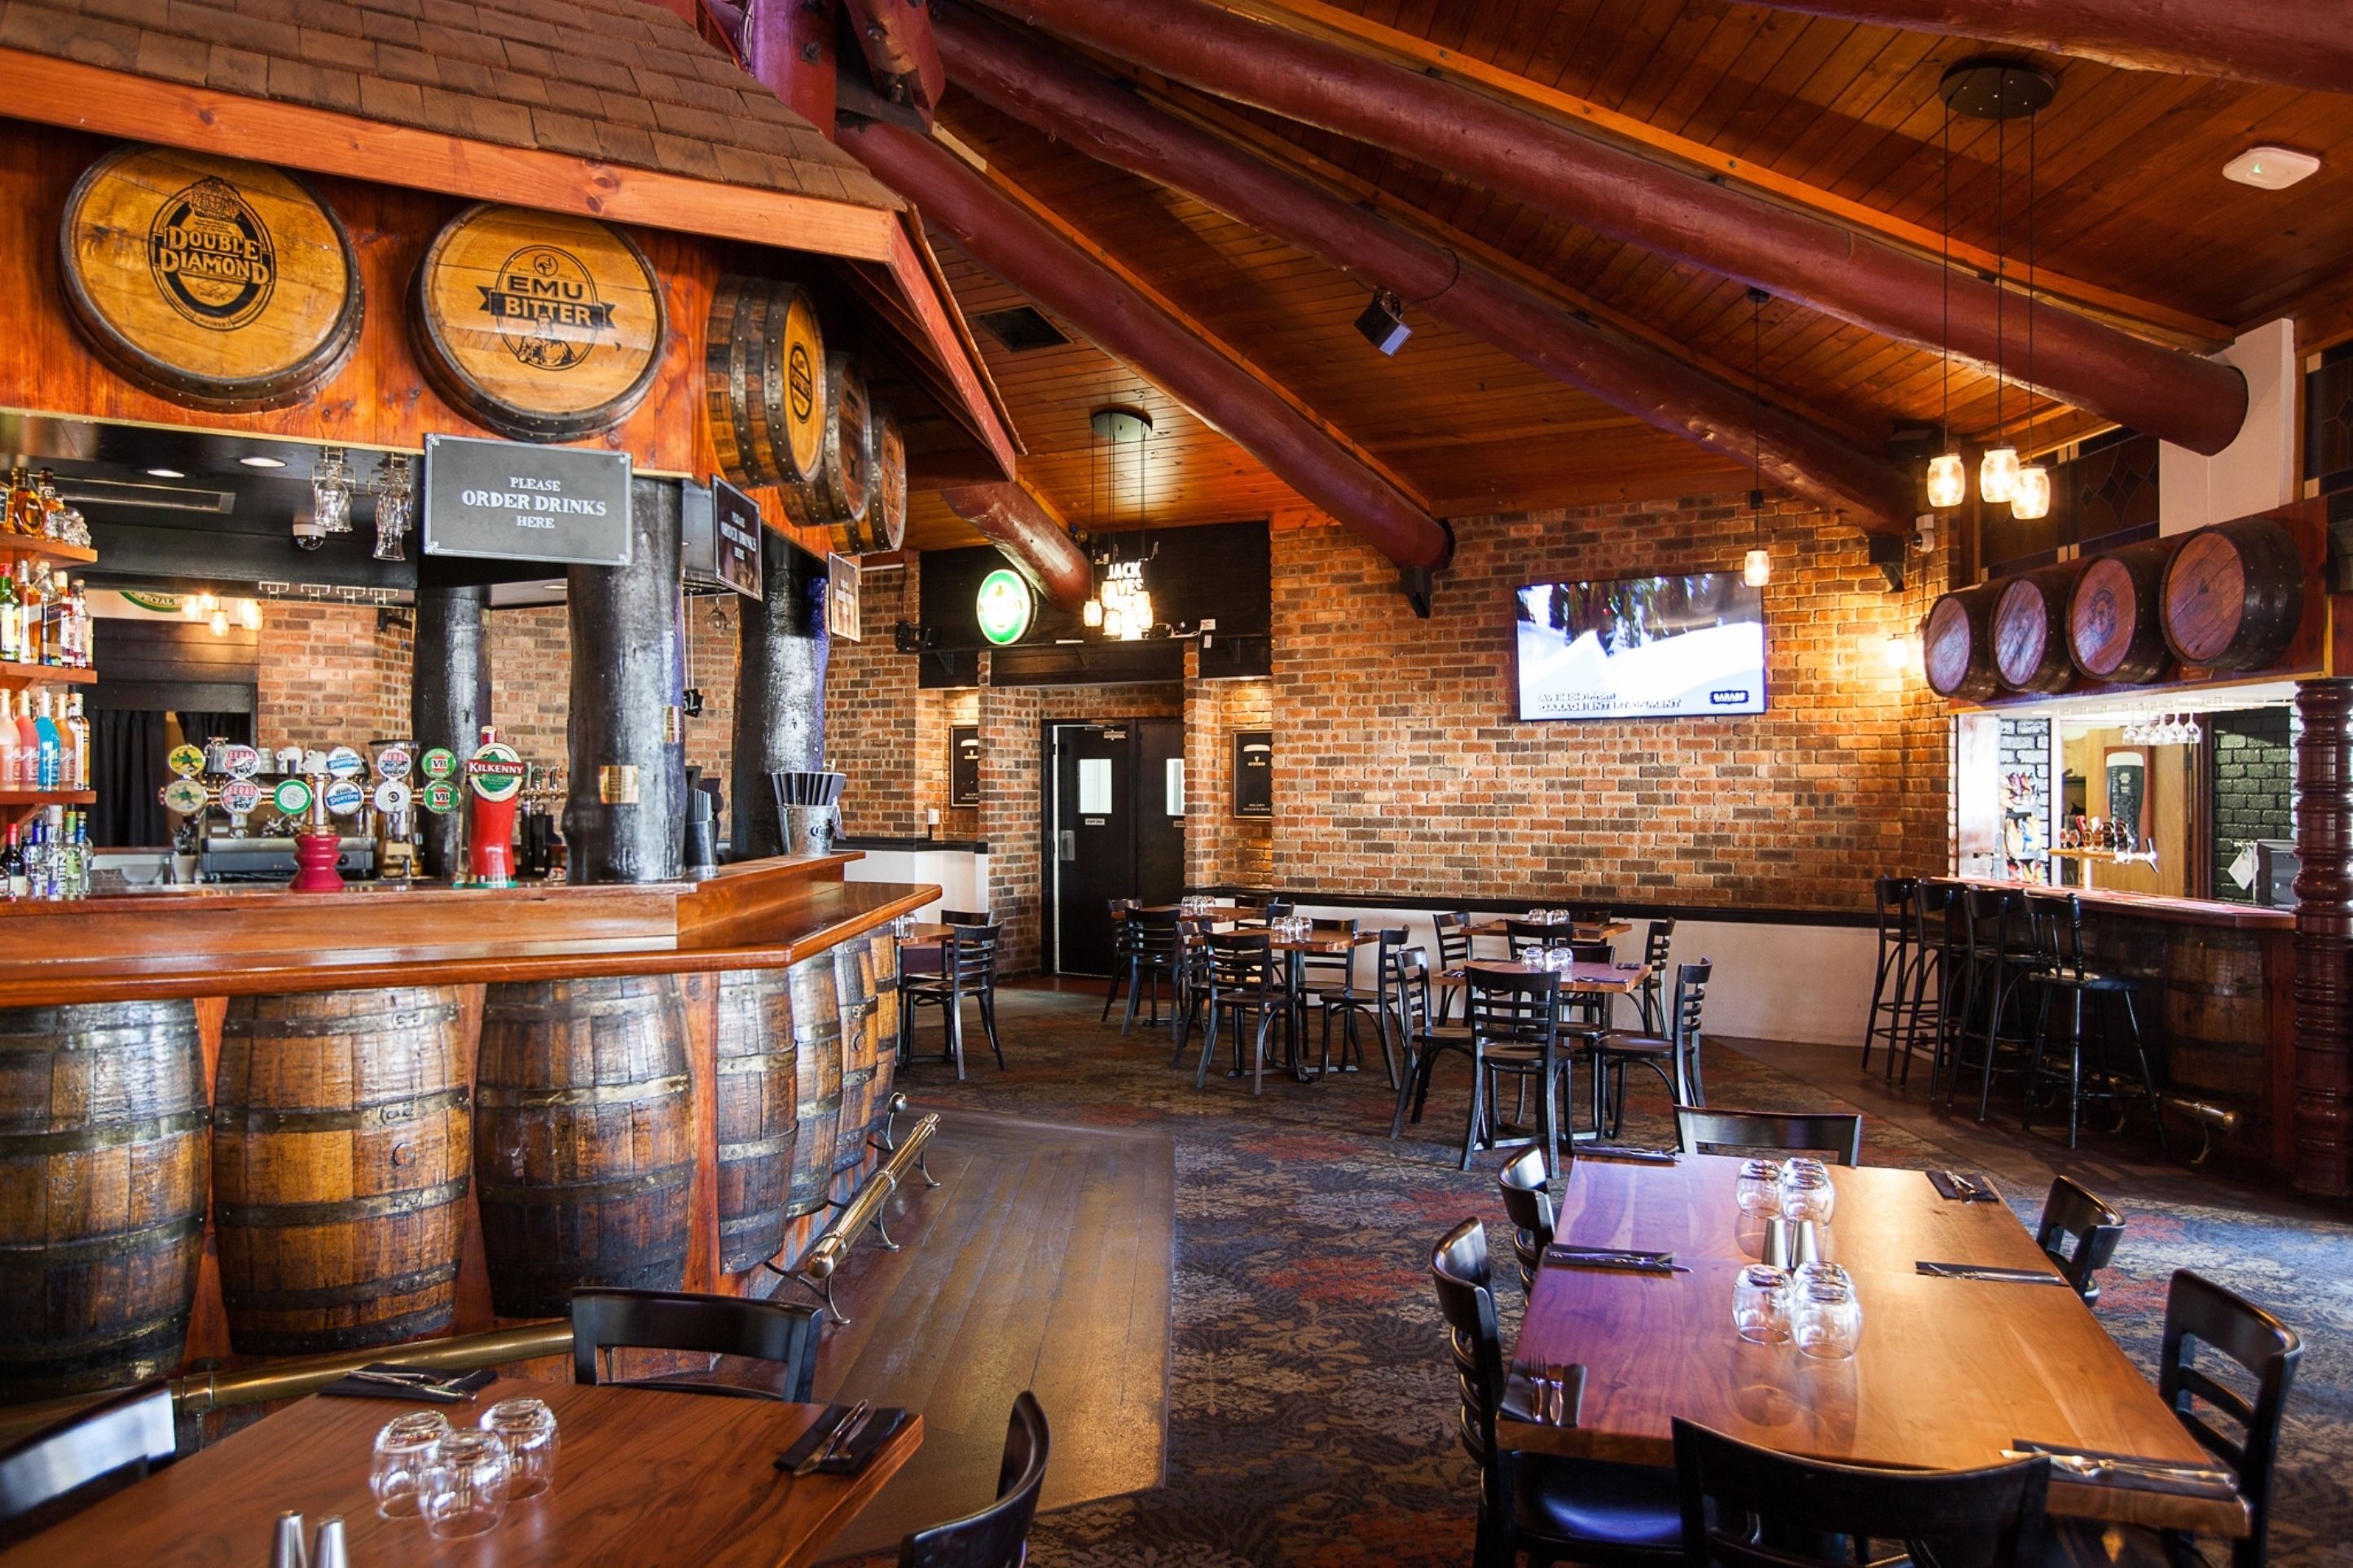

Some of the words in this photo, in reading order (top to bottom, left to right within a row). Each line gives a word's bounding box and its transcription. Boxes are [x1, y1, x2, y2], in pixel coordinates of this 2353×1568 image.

[168, 226, 261, 261] DOUBLE
[160, 248, 270, 284] DIAMOND
[508, 275, 583, 300] EMU
[504, 296, 592, 327] BITTER
[509, 477, 561, 492] PLEASE
[461, 490, 530, 510] ORDER
[534, 494, 607, 516] DRINKS
[516, 515, 556, 529] HERE
[1106, 562, 1142, 580] JACK
[433, 759, 447, 768] VB
[468, 762, 524, 774] KILKENNY
[227, 784, 256, 796] FERAL
[434, 793, 450, 802] VB
